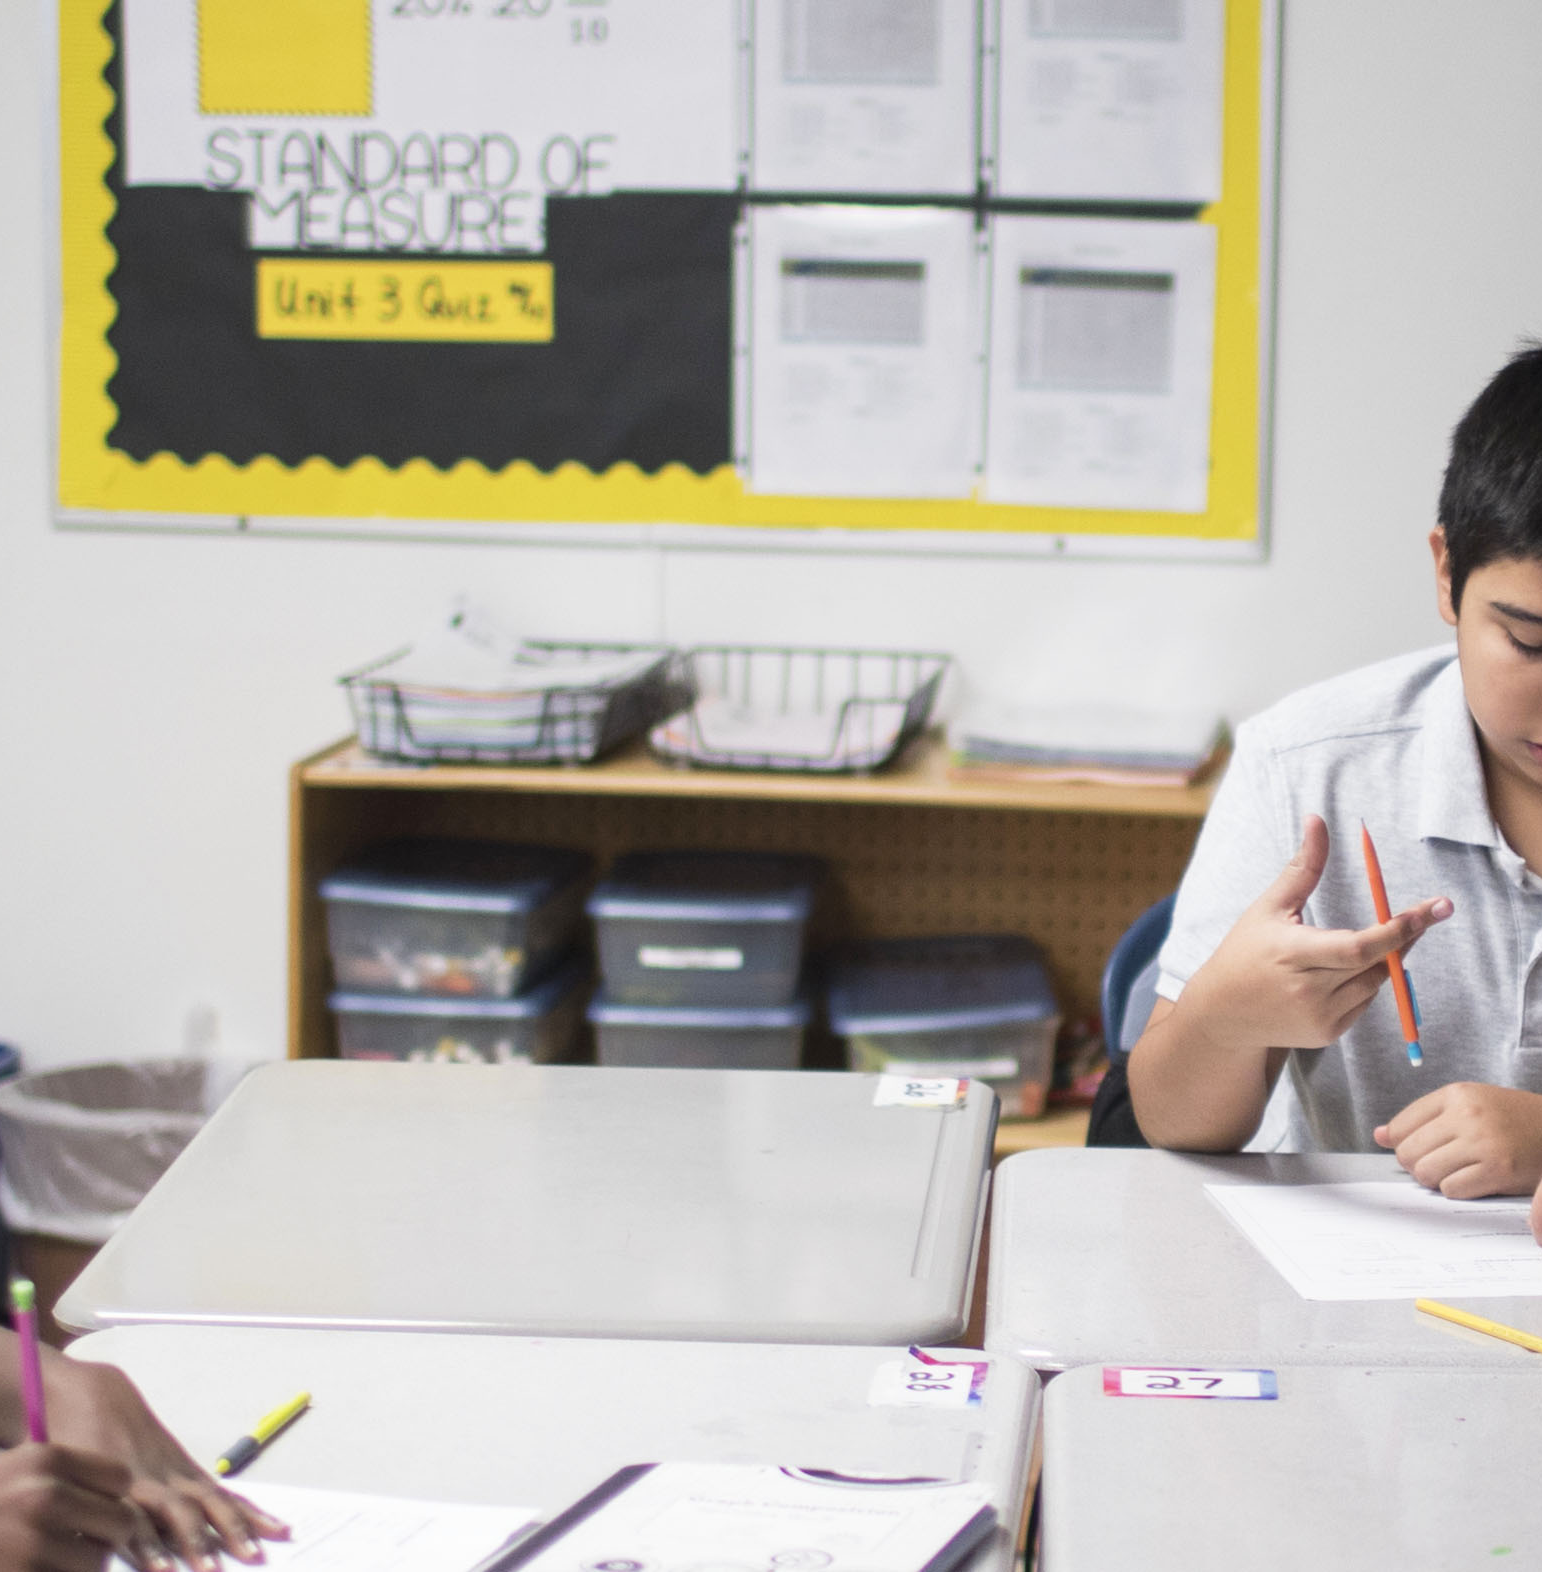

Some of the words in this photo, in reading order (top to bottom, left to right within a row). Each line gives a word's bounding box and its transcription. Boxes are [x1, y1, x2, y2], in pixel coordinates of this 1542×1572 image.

[205, 128, 519, 191] STANDARD
[540, 133, 617, 193] OF
[254, 190, 535, 250] MEASURE
[273, 276, 361, 321] Unit
[376, 276, 403, 323] 3
[415, 279, 497, 322] Quiz
[906, 1371, 957, 1393] 28
[1145, 1374, 1224, 1391] 27
